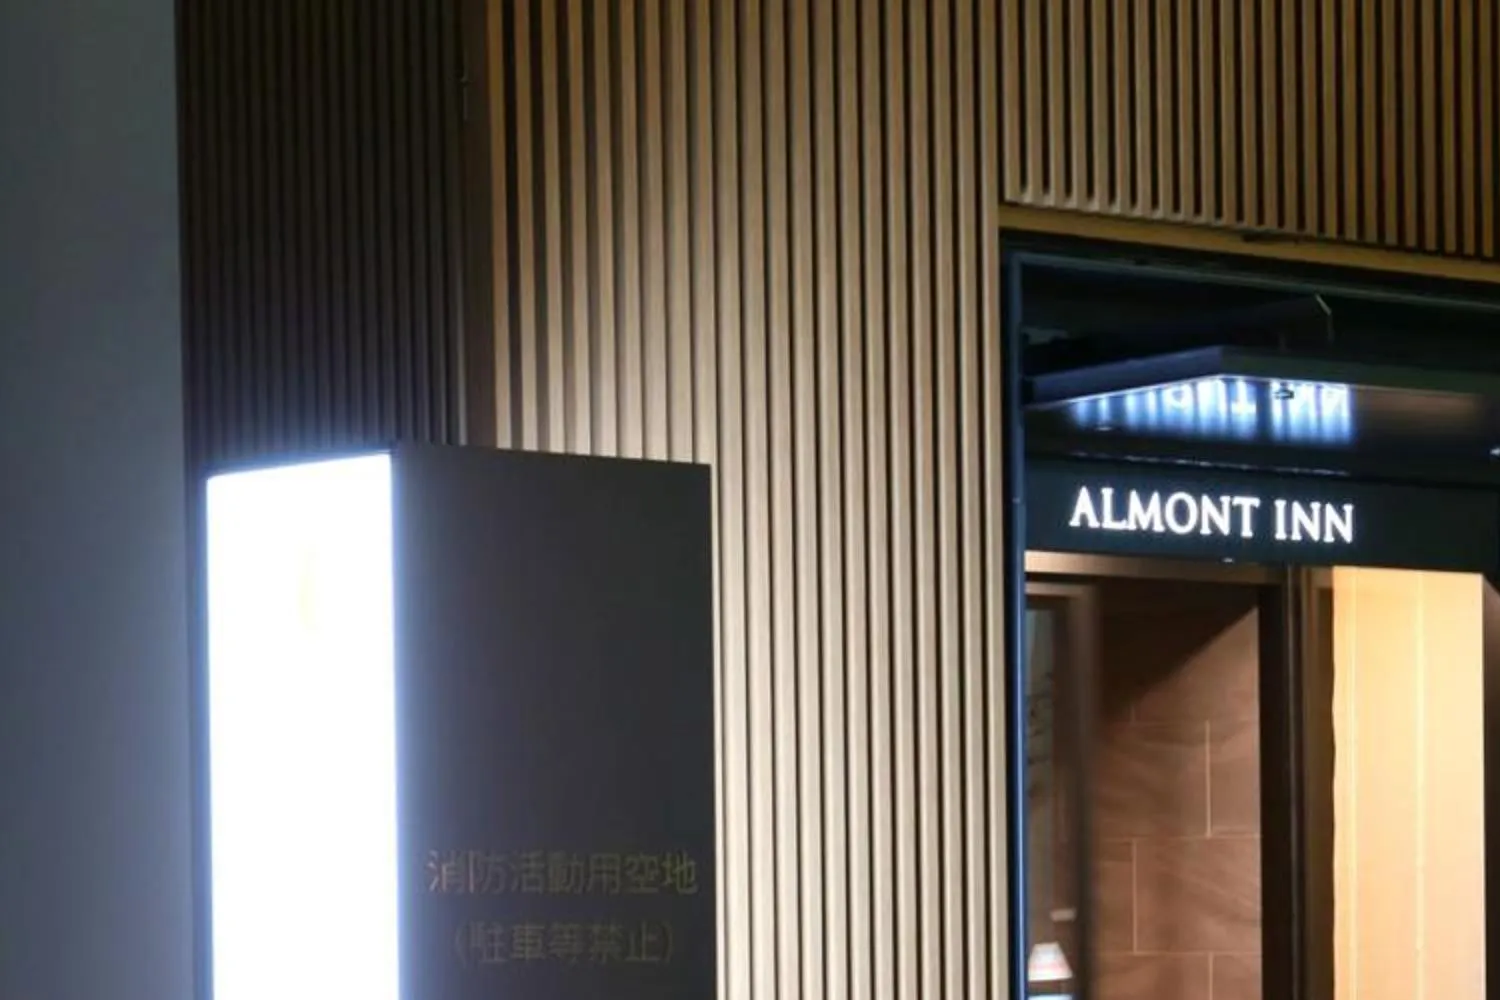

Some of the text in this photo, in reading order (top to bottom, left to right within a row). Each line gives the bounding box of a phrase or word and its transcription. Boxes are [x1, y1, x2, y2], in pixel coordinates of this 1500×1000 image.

[1068, 485, 1355, 544] ALMONT INN
[426, 849, 699, 895] 消防活動用空地
